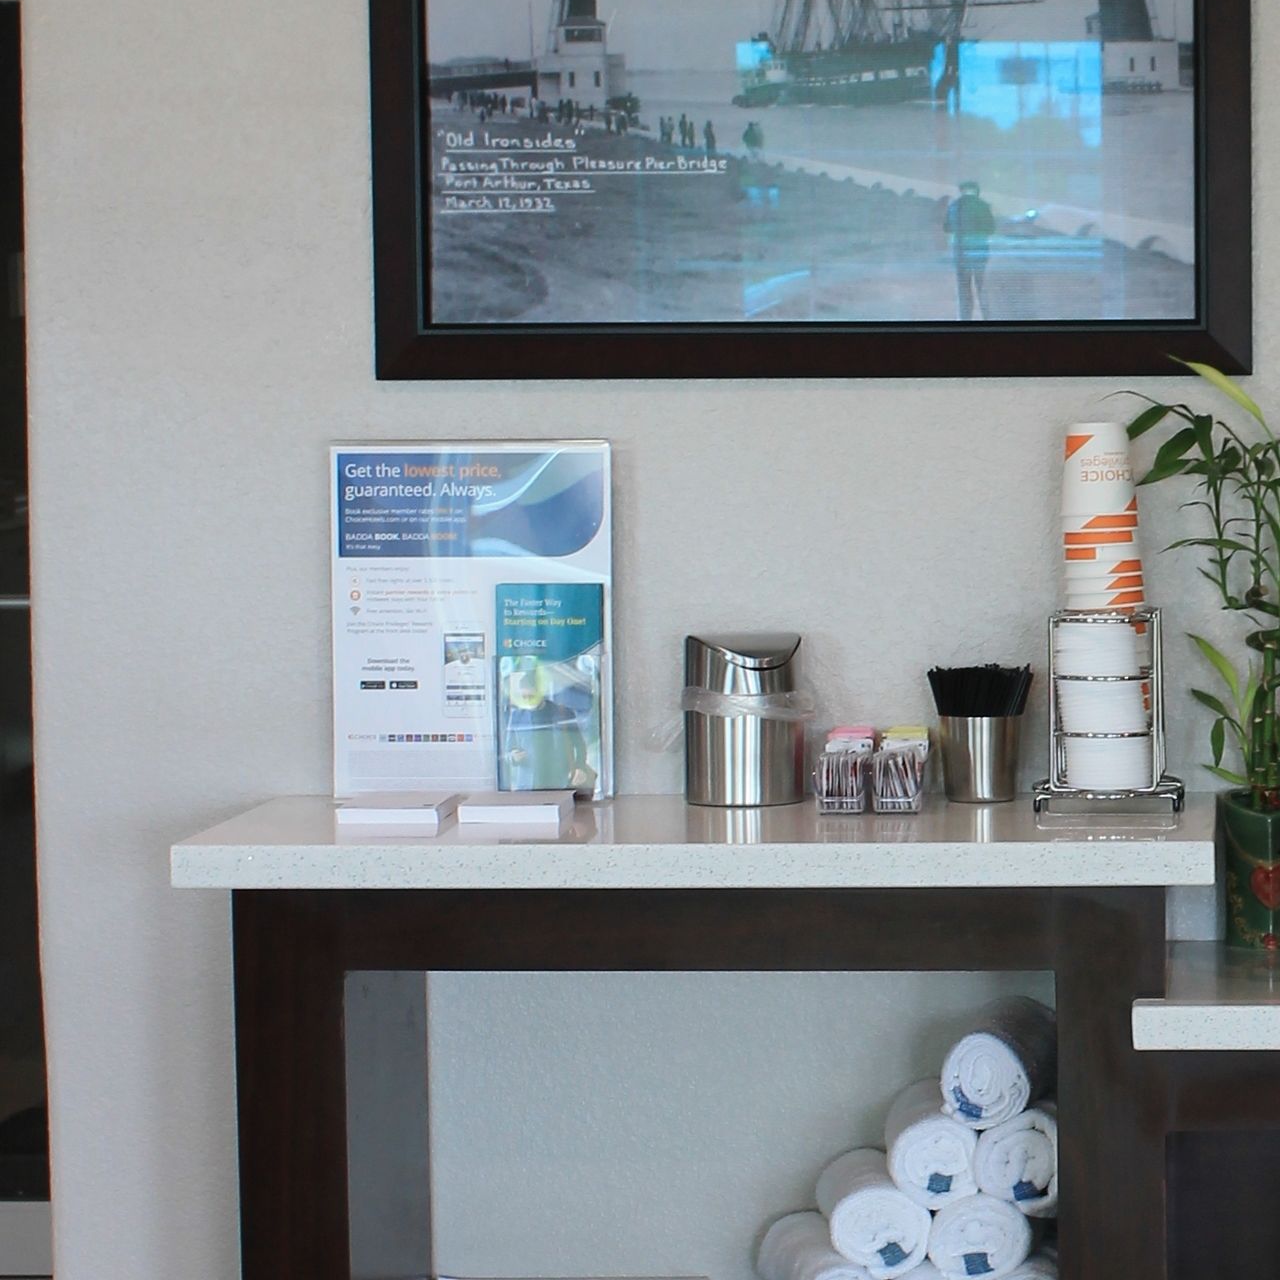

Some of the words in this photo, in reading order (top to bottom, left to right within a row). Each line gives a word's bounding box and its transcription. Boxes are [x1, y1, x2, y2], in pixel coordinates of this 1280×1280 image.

[441, 156, 498, 174] Passing
[498, 157, 564, 173] Through
[572, 156, 641, 170] Pleasure
[645, 156, 676, 170] Pier
[677, 155, 727, 172] Bridge
[445, 176, 477, 187] Port
[483, 176, 541, 190] Arthur,
[543, 178, 591, 189] Texas
[445, 197, 492, 208] March
[345, 463, 372, 478] Get
[376, 463, 401, 478] the
[404, 463, 455, 478] lowest
[1080, 470, 1131, 482] CHOICE
[344, 483, 436, 501] guaranteed.
[440, 483, 496, 501] Always.
[513, 639, 547, 648] CHOICE
